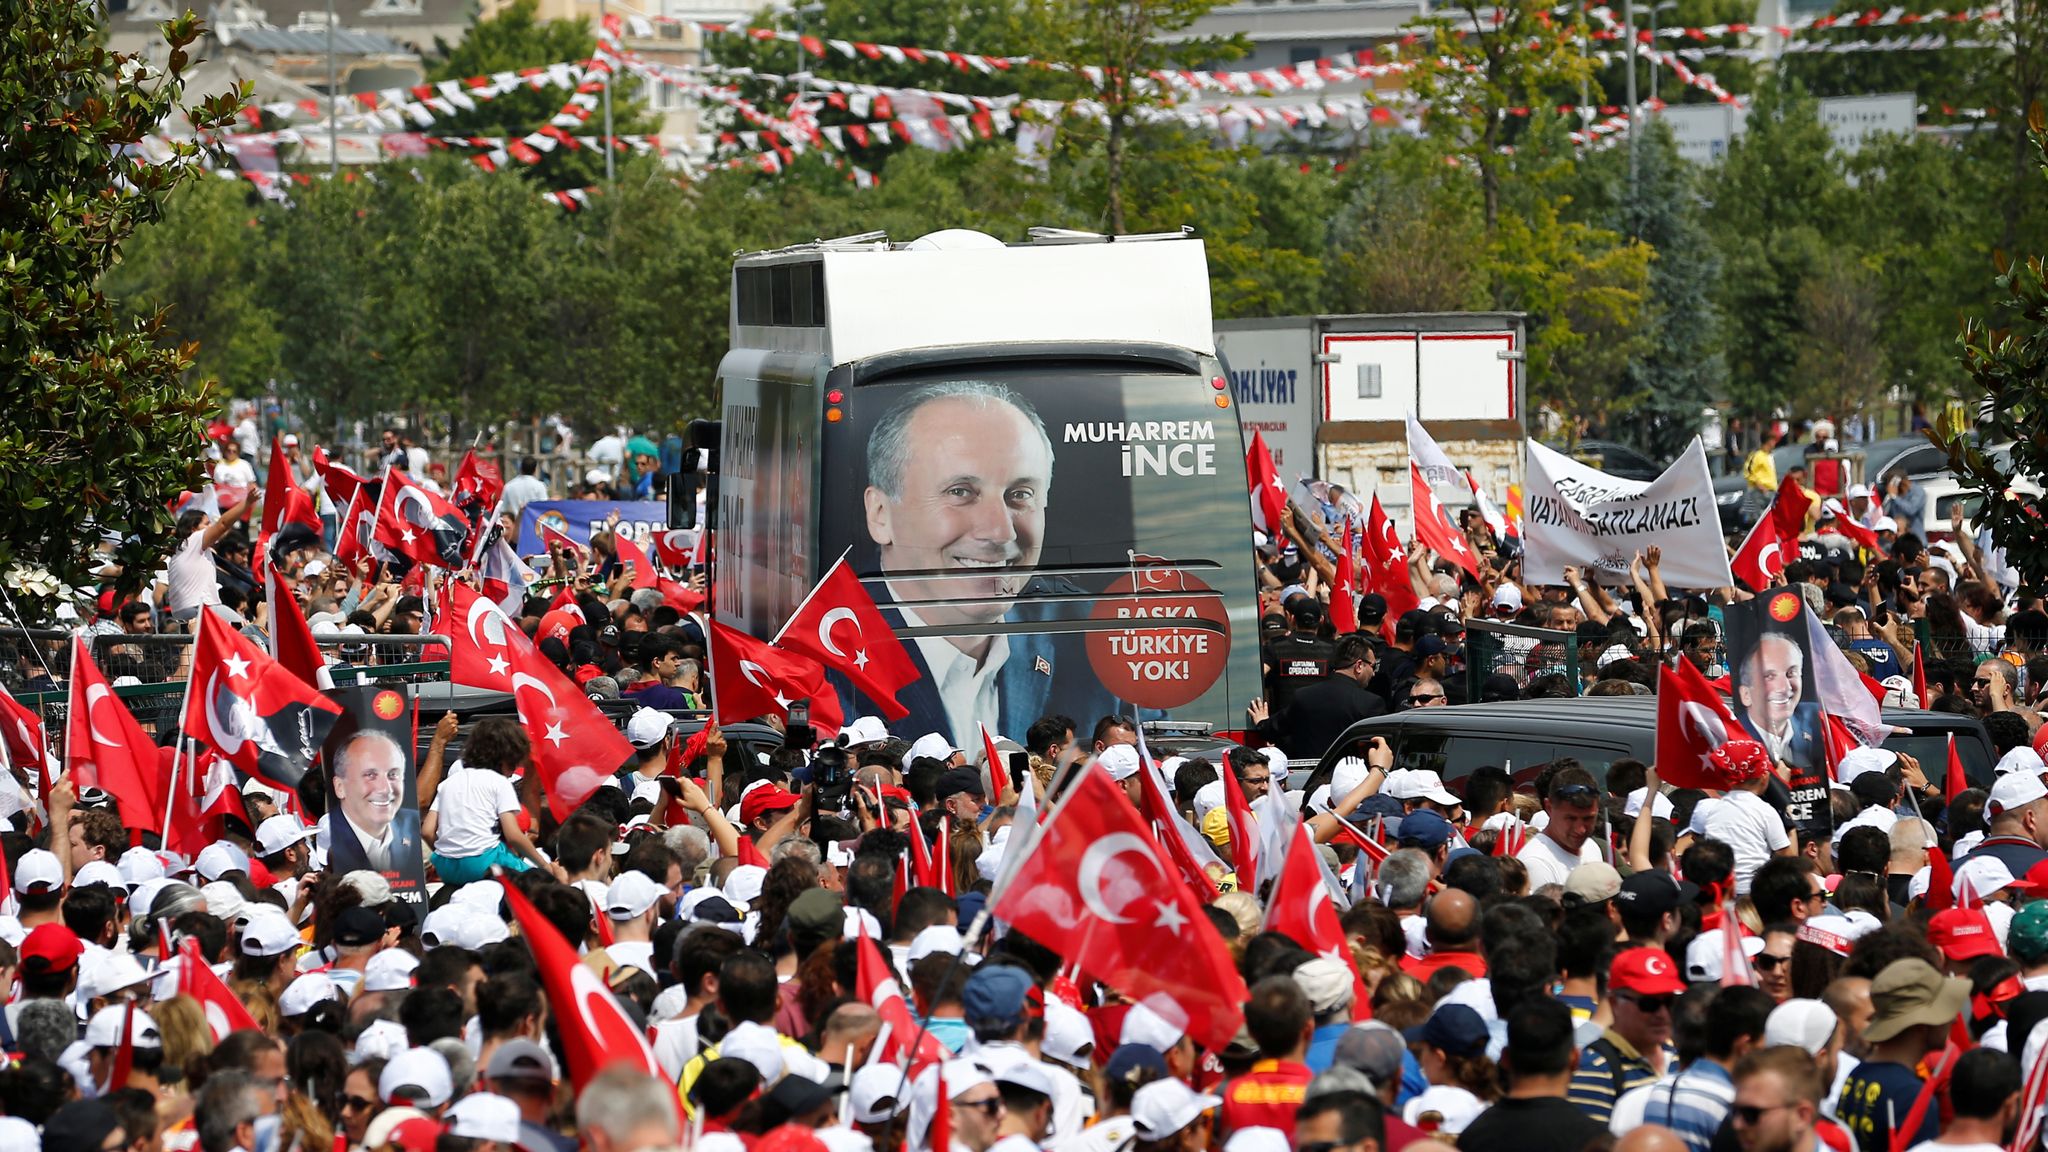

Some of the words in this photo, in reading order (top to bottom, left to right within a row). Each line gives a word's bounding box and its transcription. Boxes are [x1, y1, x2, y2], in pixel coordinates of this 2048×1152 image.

[1064, 421, 1215, 442] MUHARREM
[1121, 443, 1217, 476] İNCE
[1108, 629, 1208, 655] TÜRKİYE
[1127, 660, 1190, 681] YOK!
